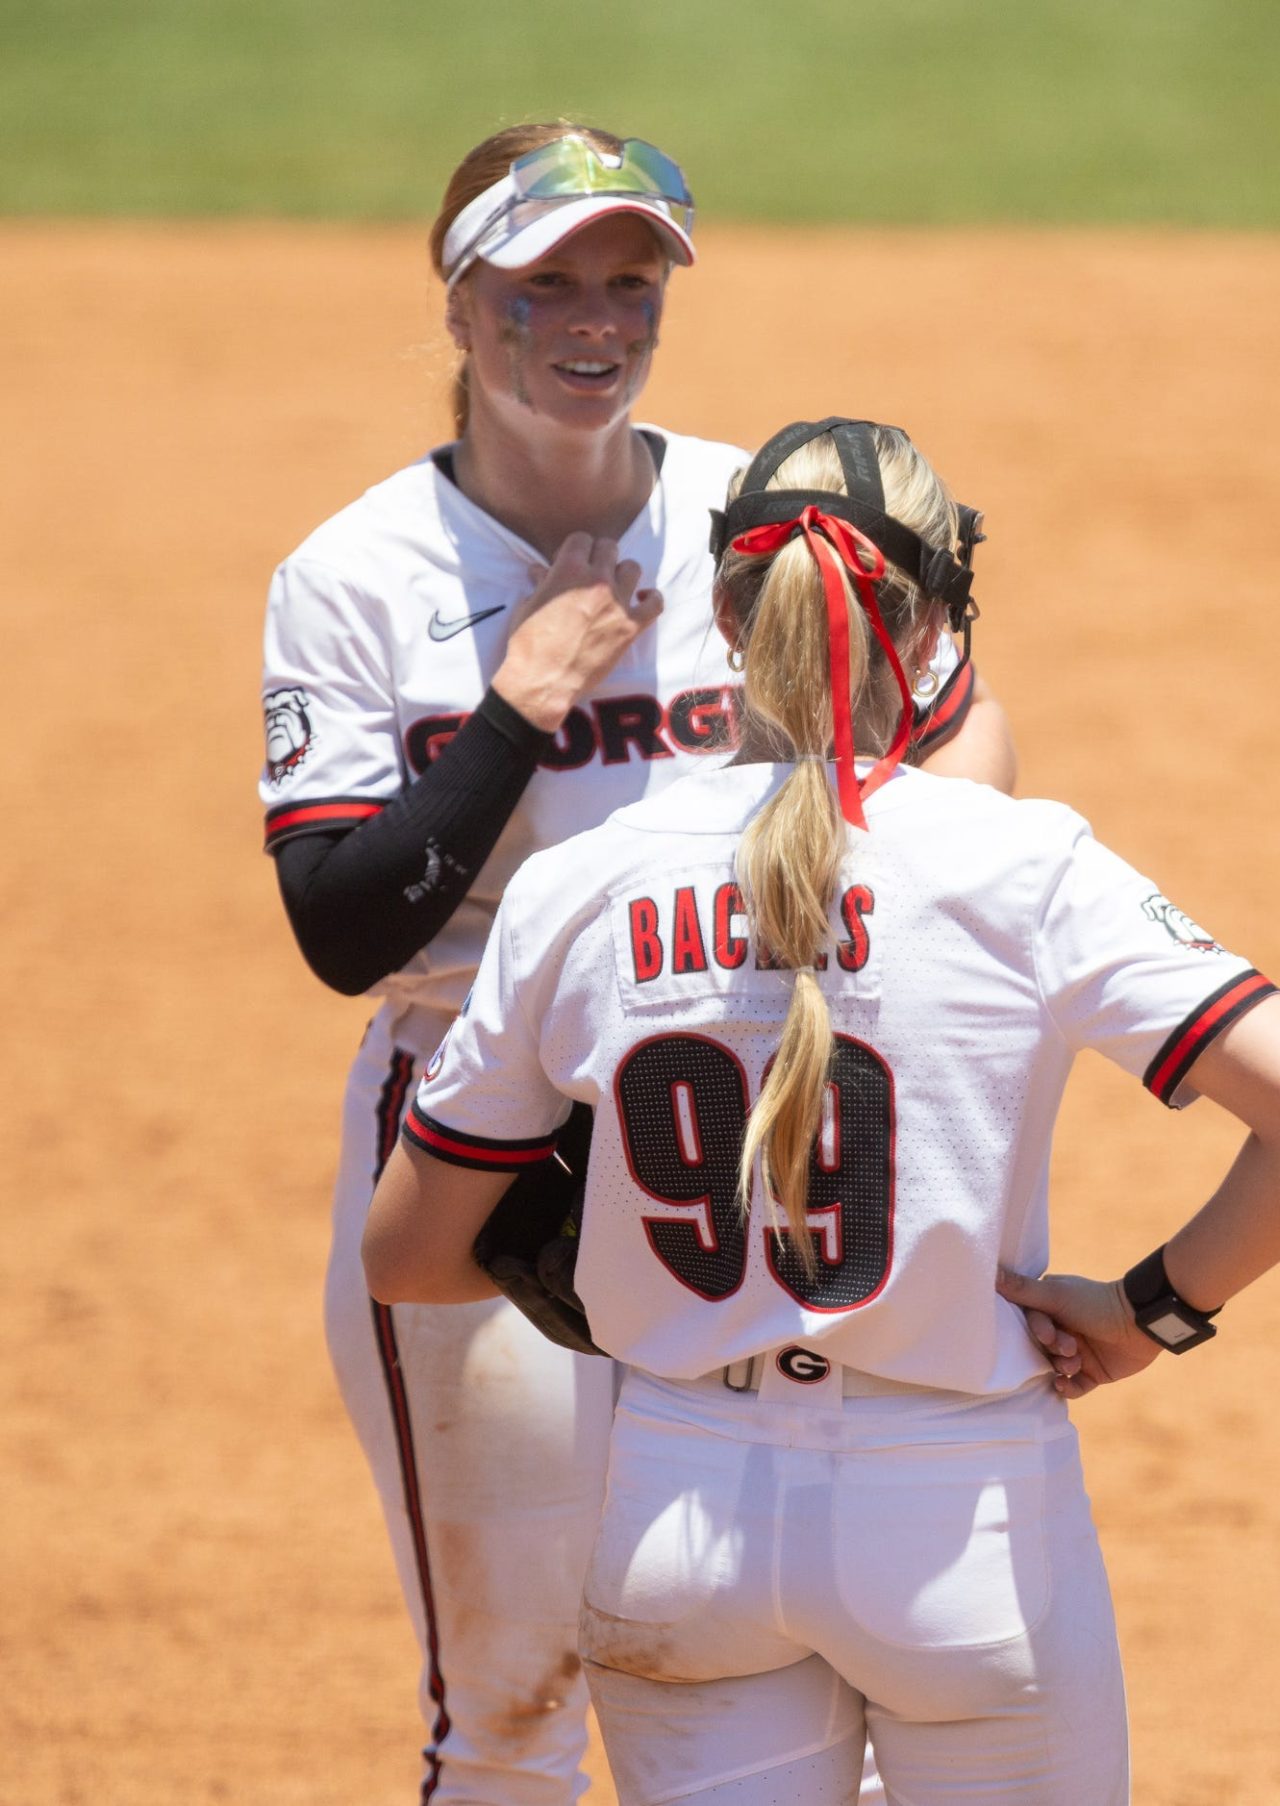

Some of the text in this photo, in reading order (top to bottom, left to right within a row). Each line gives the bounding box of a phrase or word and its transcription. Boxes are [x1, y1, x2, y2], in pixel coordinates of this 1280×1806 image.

[628, 881, 876, 984] BACS
[613, 1031, 897, 1314] 99
[776, 1345, 831, 1385] G
